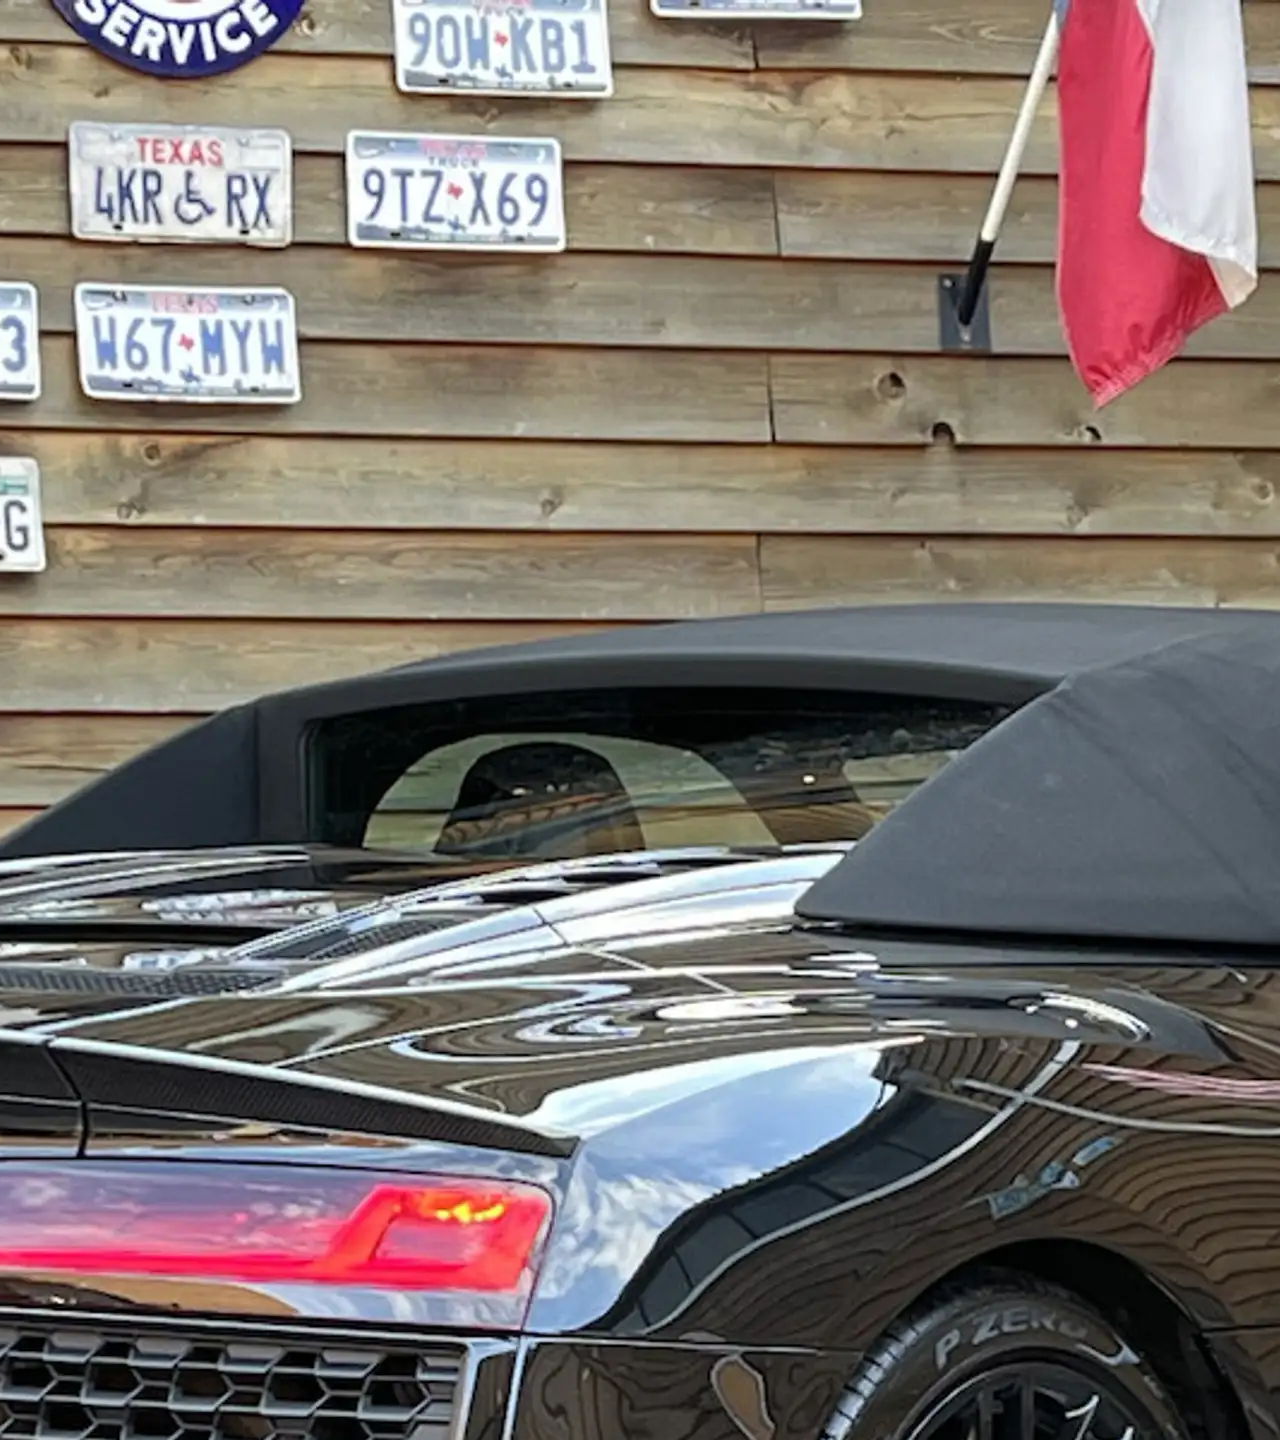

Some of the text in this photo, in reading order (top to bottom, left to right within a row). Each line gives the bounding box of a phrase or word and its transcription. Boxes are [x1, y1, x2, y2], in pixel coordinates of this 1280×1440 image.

[74, 0, 279, 65] SERVICE
[408, 12, 597, 74] 90W KB1
[136, 137, 224, 167] TEXAS
[94, 166, 273, 229] 4KR RX
[362, 167, 549, 227] 9TZ X69
[92, 315, 286, 376] W67 MYW
[3, 499, 30, 552] G
